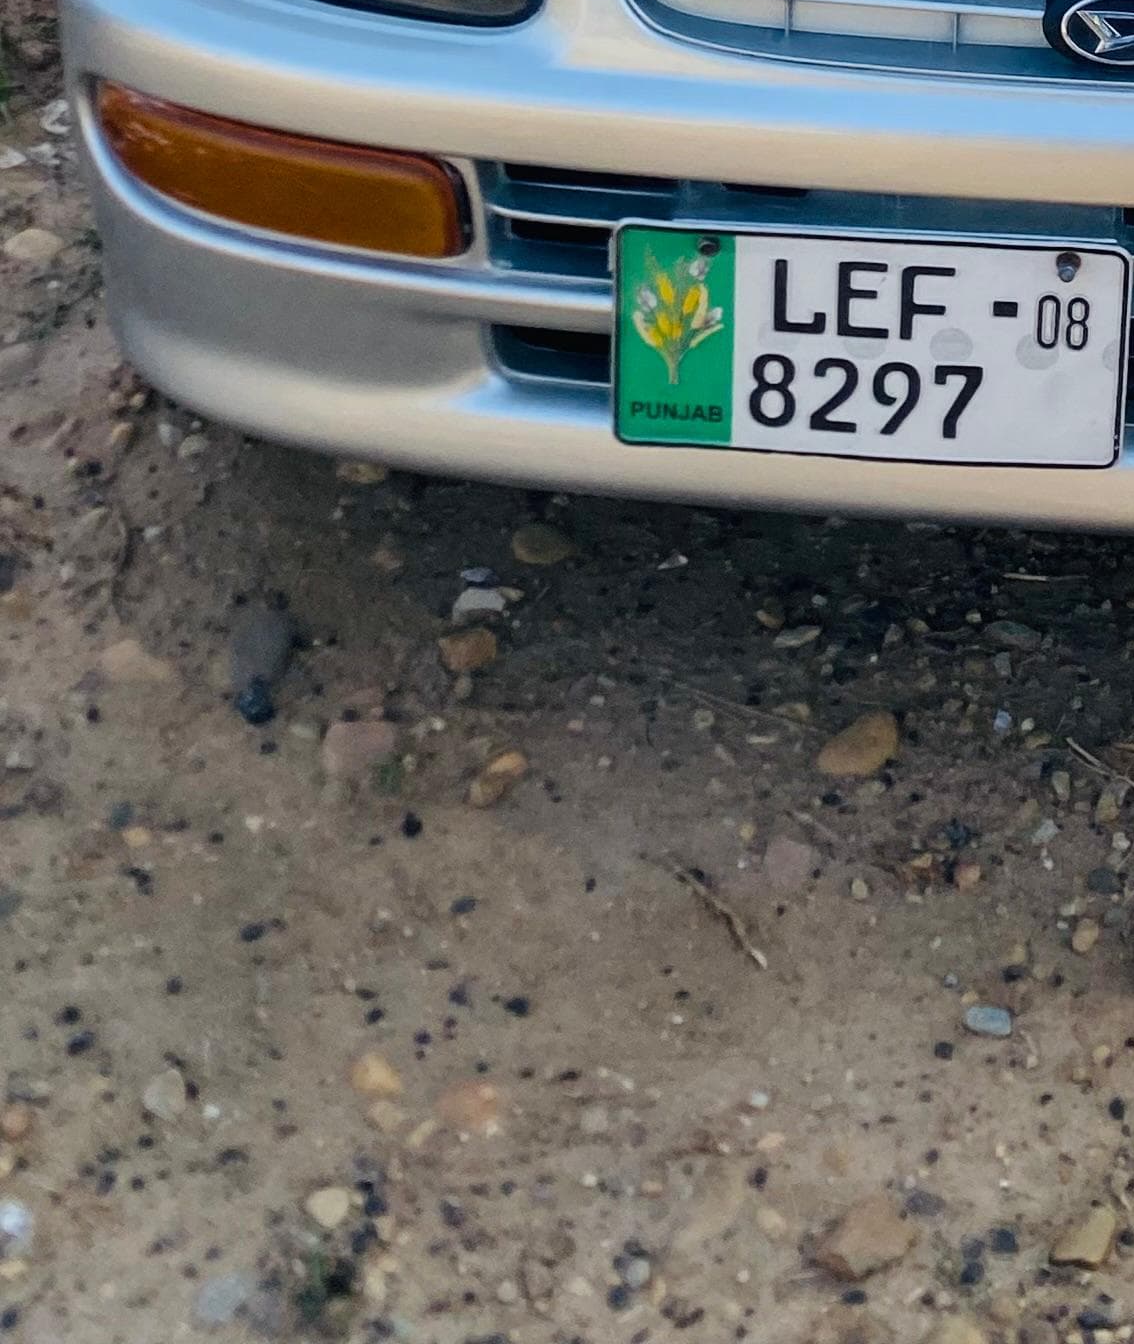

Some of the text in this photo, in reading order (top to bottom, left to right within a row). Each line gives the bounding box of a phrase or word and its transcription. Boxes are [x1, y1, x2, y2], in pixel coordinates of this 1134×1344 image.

[773, 258, 956, 340] LEF
[629, 400, 724, 424] PUNJAB
[748, 353, 983, 439] 8297
